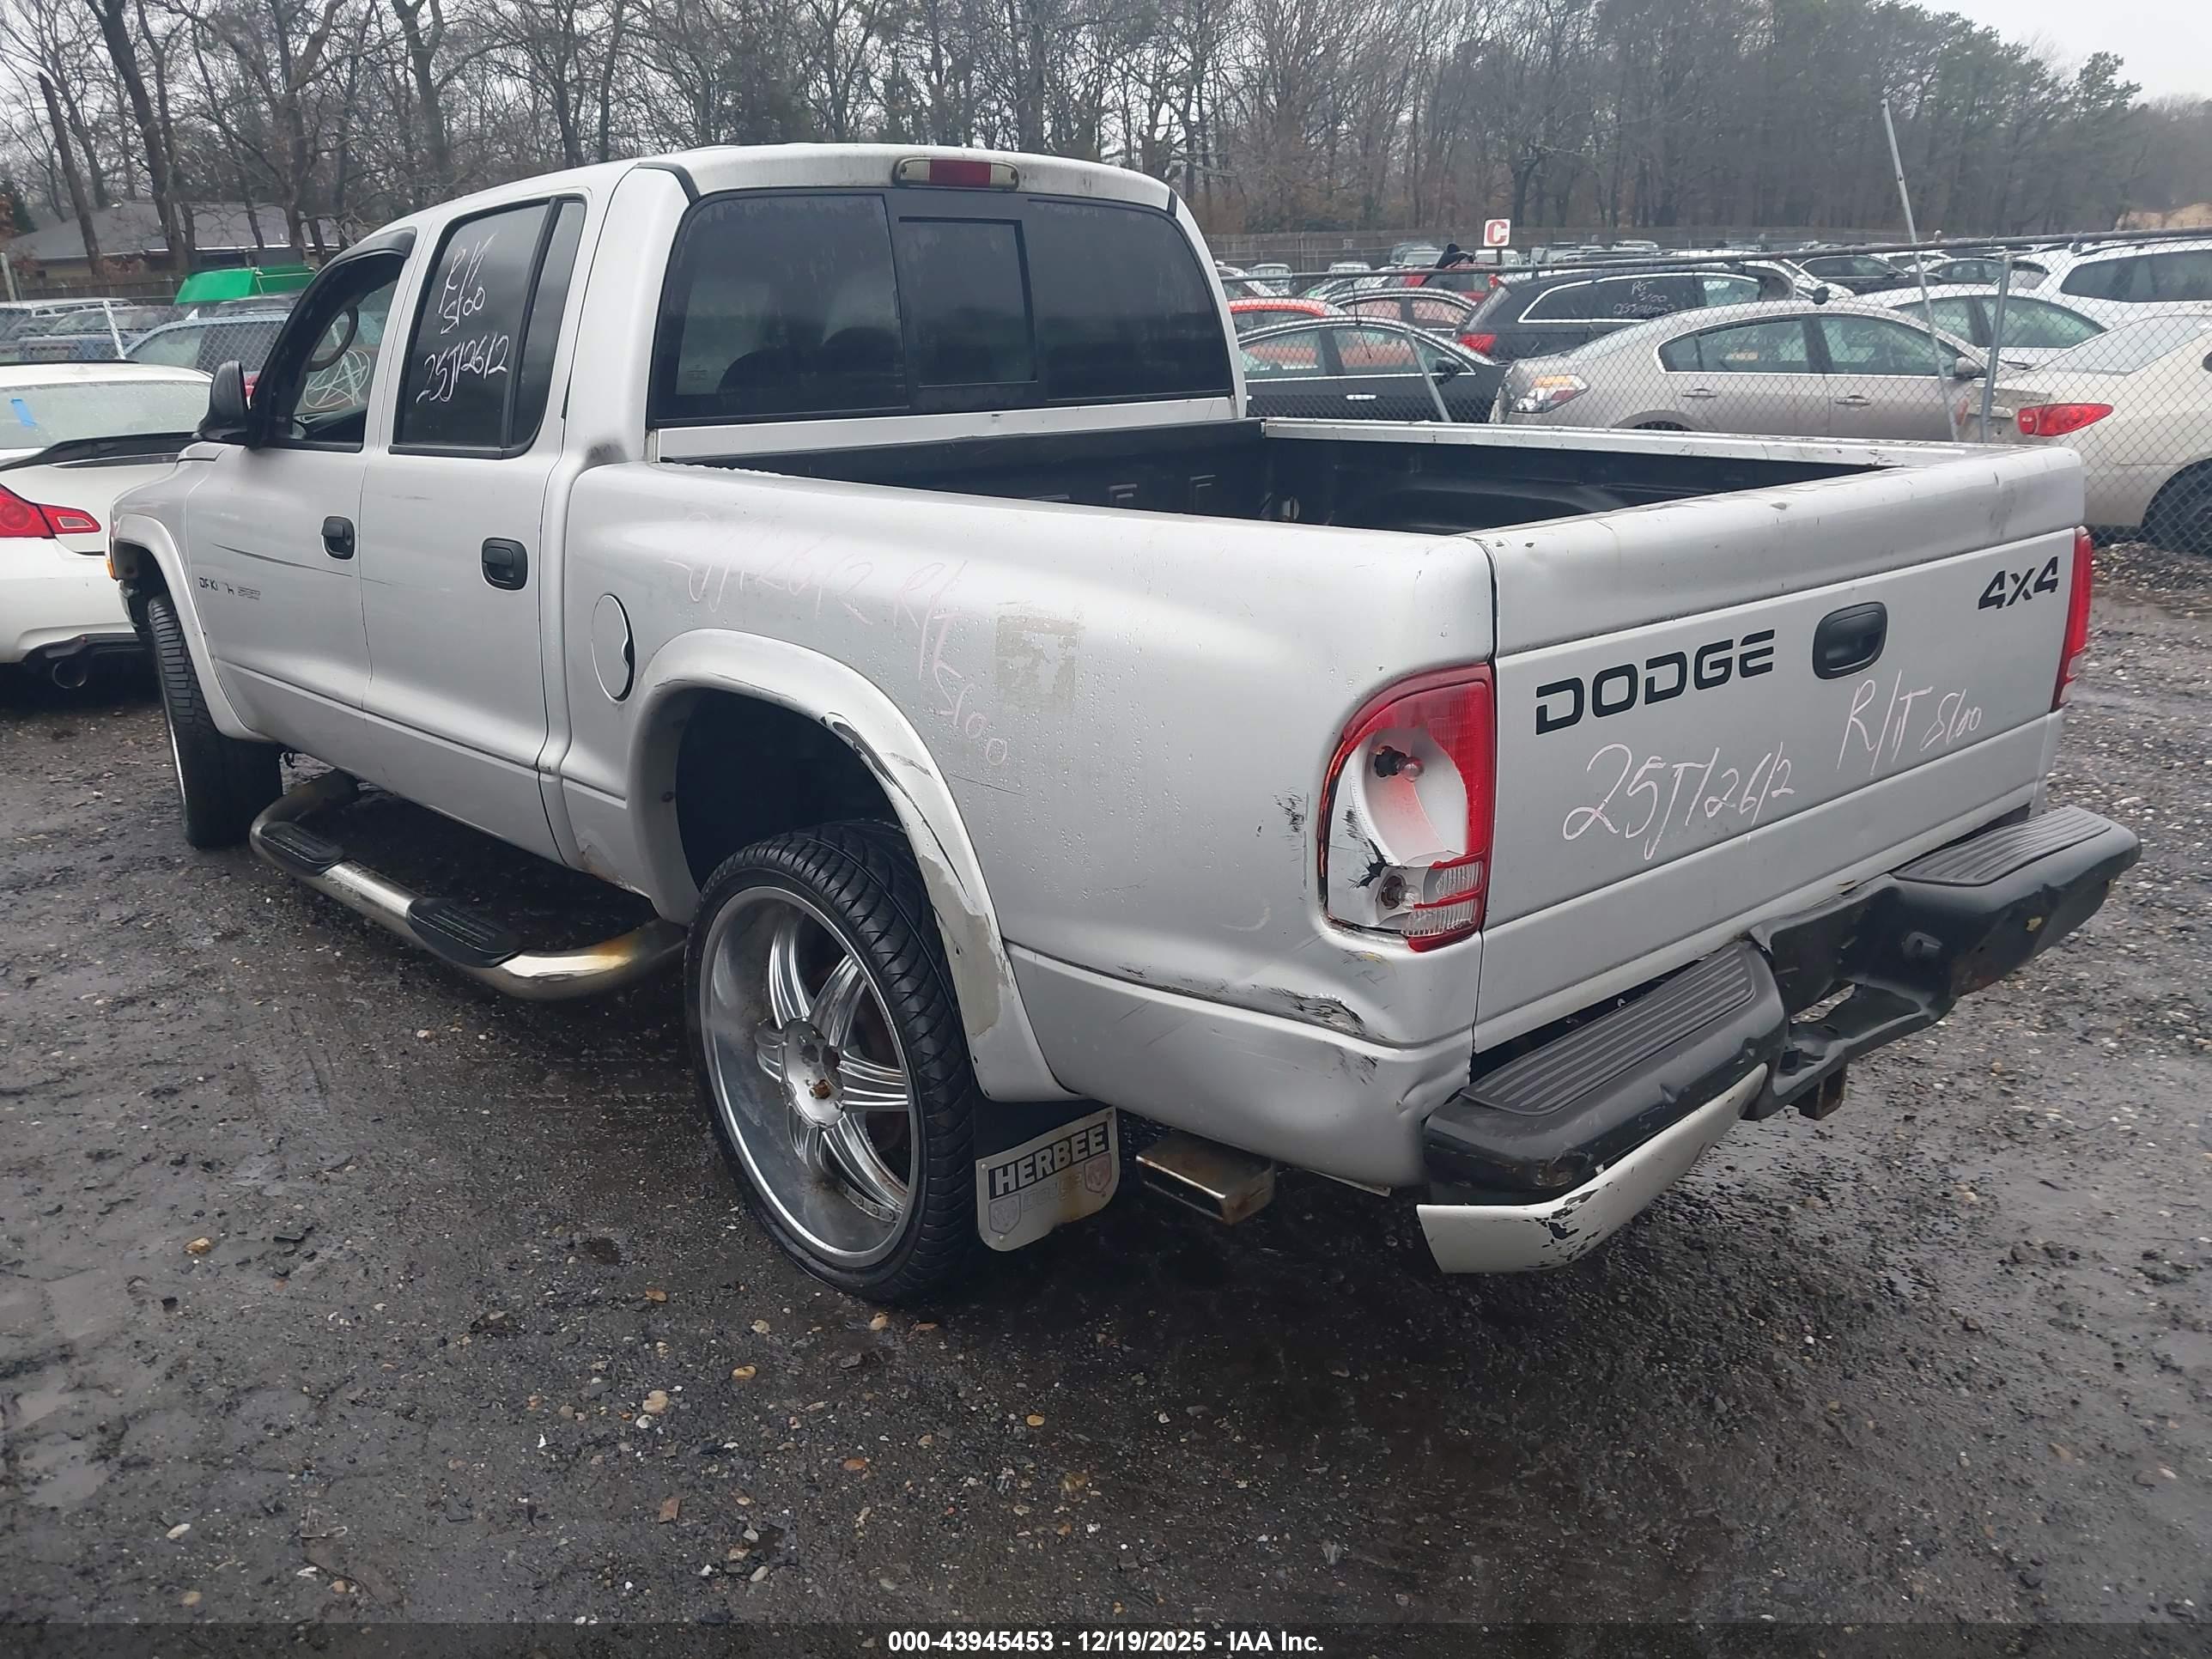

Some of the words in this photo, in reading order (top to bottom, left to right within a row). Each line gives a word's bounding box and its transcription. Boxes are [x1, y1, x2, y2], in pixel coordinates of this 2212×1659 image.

[1487, 221, 1508, 245] C
[1534, 629, 1775, 736] DODGE
[994, 1124, 1107, 1196] HERBEE
